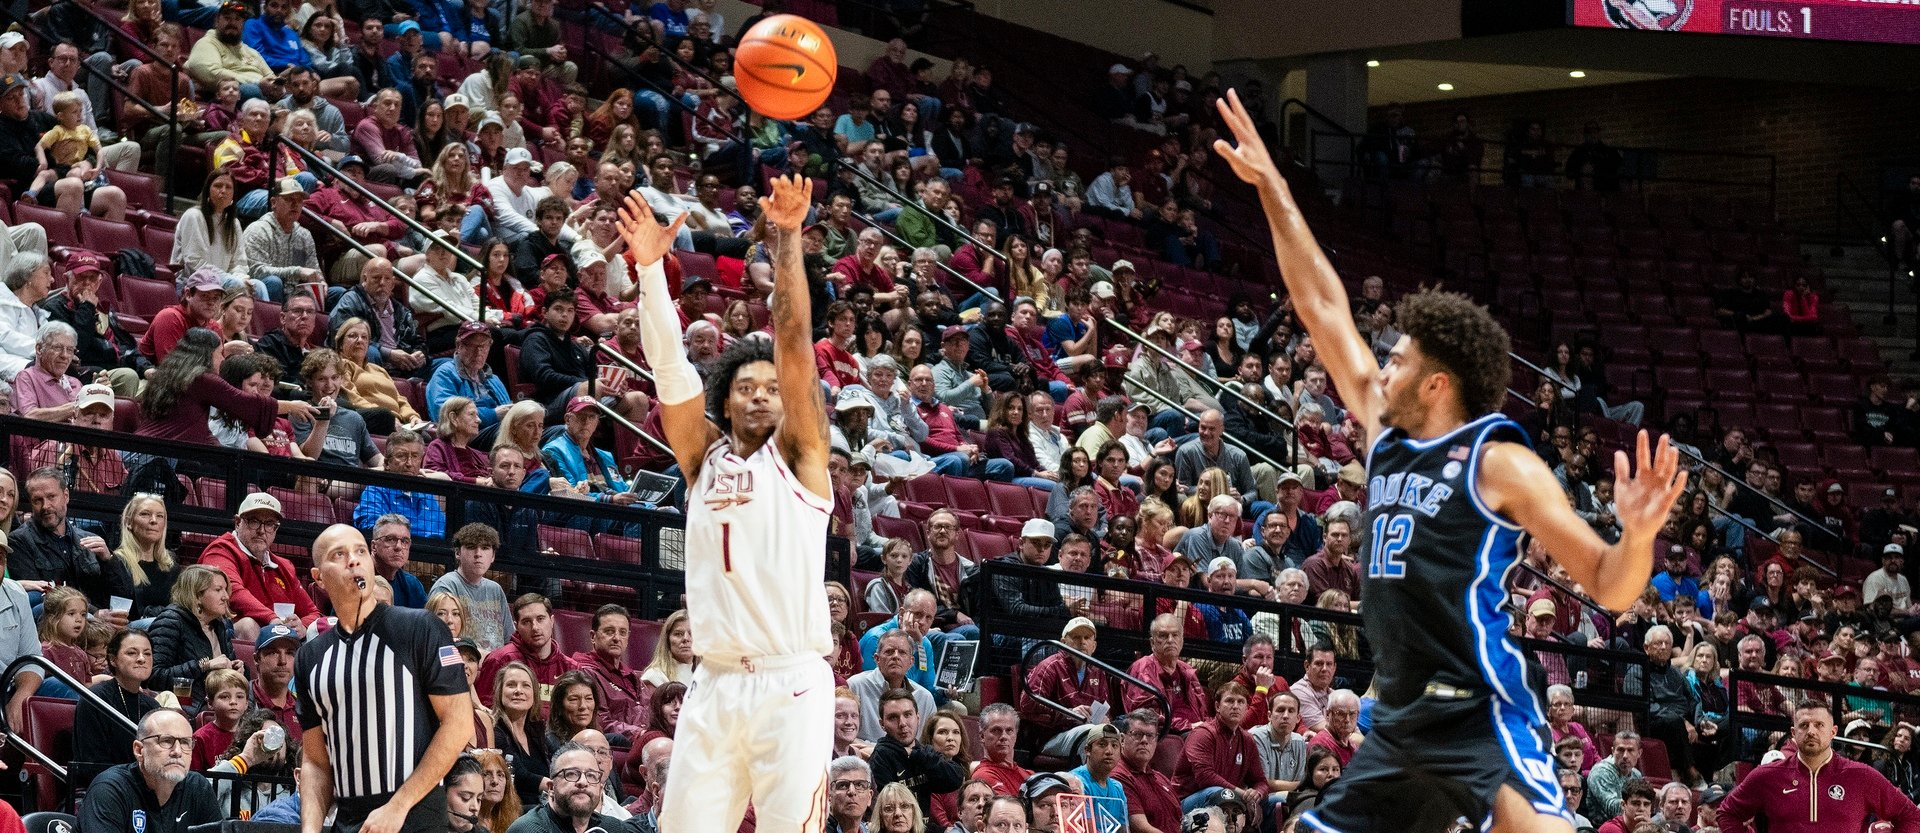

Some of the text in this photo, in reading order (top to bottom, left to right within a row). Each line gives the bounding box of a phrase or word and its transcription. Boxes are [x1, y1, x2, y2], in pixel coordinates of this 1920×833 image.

[1801, 7, 1811, 34] 1
[704, 470, 753, 495] SU
[1369, 472, 1454, 518] DUKE
[722, 522, 732, 572] 1
[1368, 513, 1415, 578] 12
